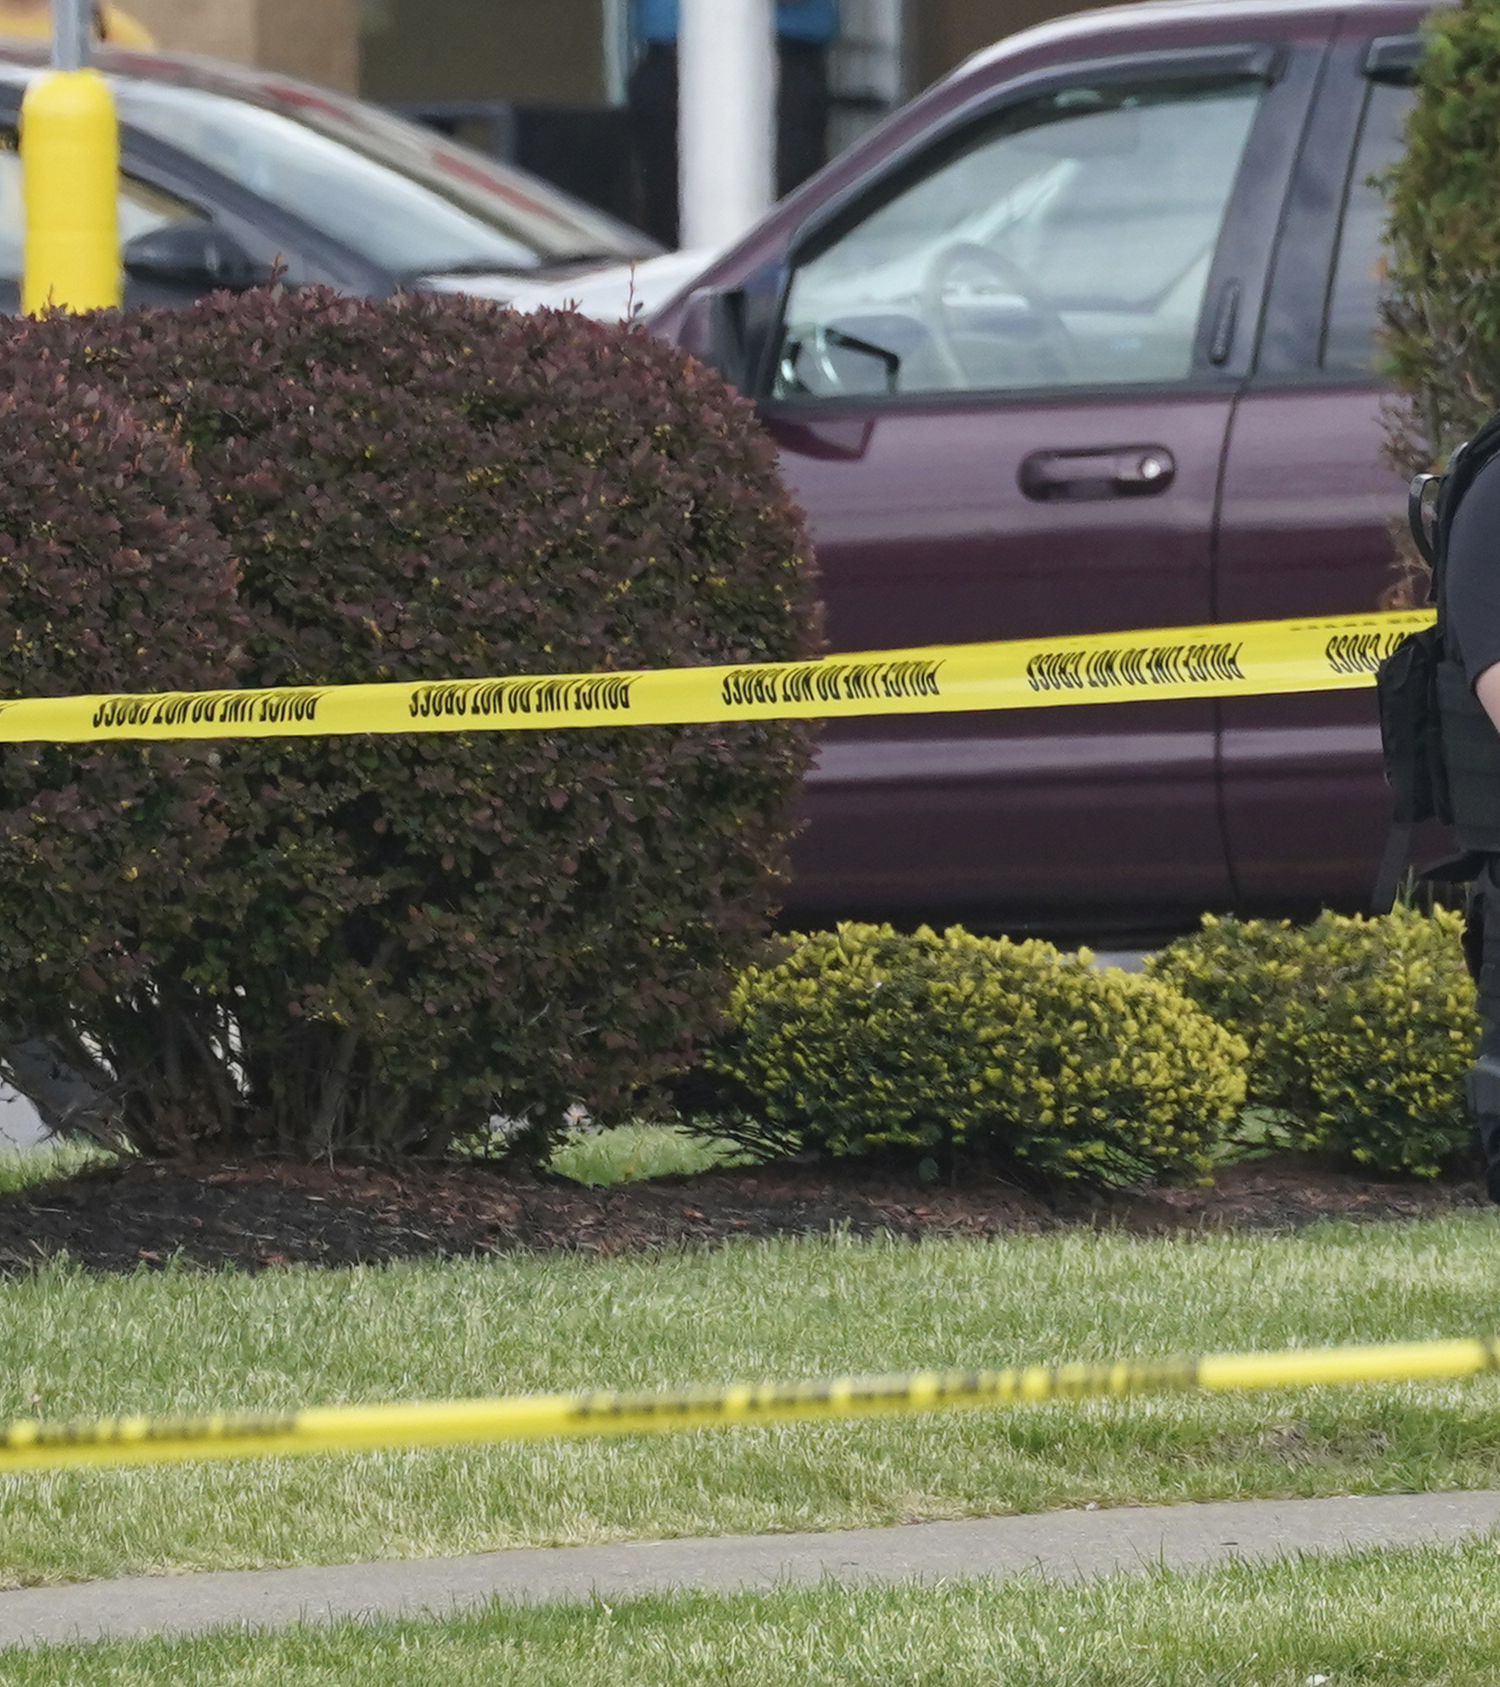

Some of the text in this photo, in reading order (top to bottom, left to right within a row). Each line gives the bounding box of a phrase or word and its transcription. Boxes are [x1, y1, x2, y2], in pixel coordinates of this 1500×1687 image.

[722, 661, 943, 706] POLICE LINE DO NOT CROSS
[1026, 642, 1245, 692] POLICE LINE DO NOT CROSS
